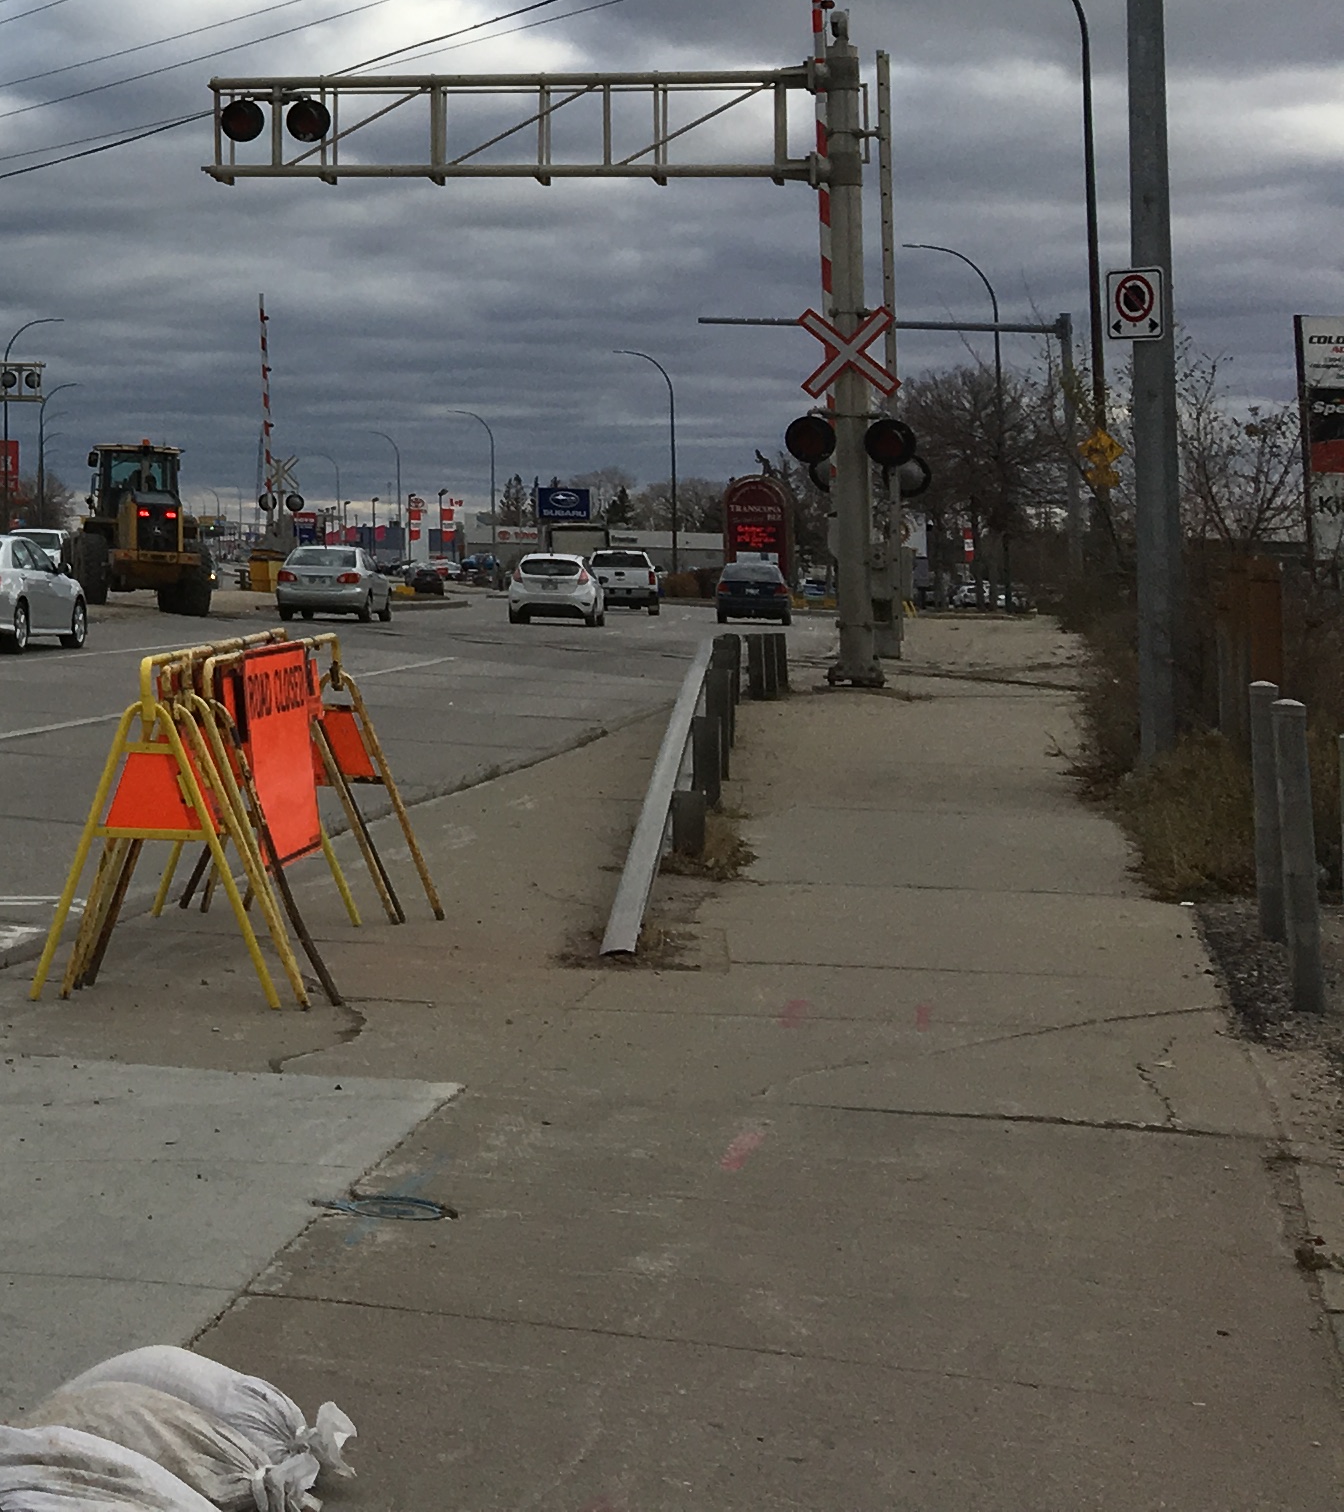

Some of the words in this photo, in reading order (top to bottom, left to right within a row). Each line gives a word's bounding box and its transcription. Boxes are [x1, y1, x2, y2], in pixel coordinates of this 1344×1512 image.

[542, 509, 587, 518] SUBARU
[247, 671, 273, 720] ROAD
[274, 664, 305, 714] CLOSED
